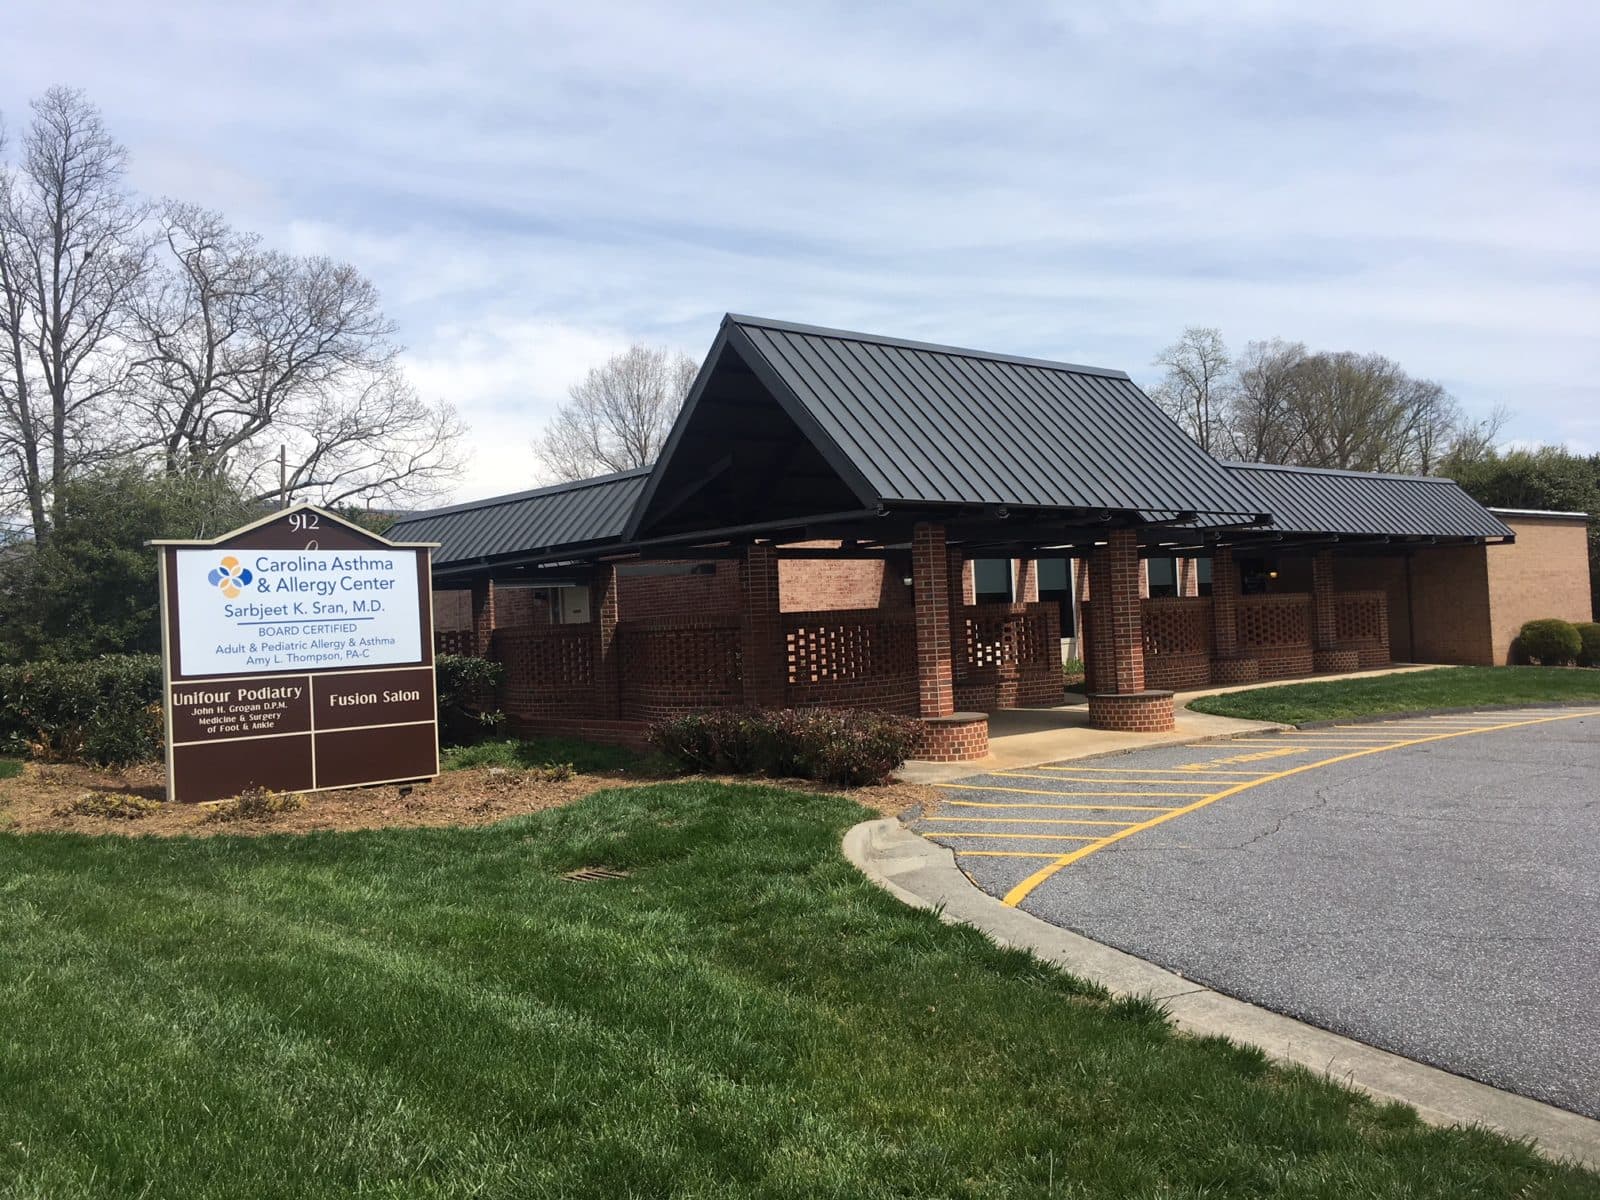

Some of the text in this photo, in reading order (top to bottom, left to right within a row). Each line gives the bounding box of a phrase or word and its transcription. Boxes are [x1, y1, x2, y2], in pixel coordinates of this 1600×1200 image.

[288, 513, 320, 533] 912
[255, 555, 393, 573] Carolina Asthma
[257, 576, 395, 595] & Allergy Center
[224, 600, 384, 620] Sarbjeet K. Sran, M.D.
[259, 624, 357, 636] BOARD CERTIFIED
[216, 636, 395, 654] Adult & Pediatric Allergy & Asthma
[246, 649, 370, 666] Amy L. Thompson, PA-C
[173, 685, 302, 706] Unifour Podiatry
[330, 689, 420, 706] Fusion Salon
[191, 707, 214, 716] John
[229, 704, 261, 713] Grogan
[263, 701, 288, 710] D.P.M.
[199, 716, 237, 725] Medicine
[249, 712, 281, 722] Surgery
[207, 725, 217, 734] of
[220, 724, 240, 732] Foot
[252, 721, 274, 729] Ankle
